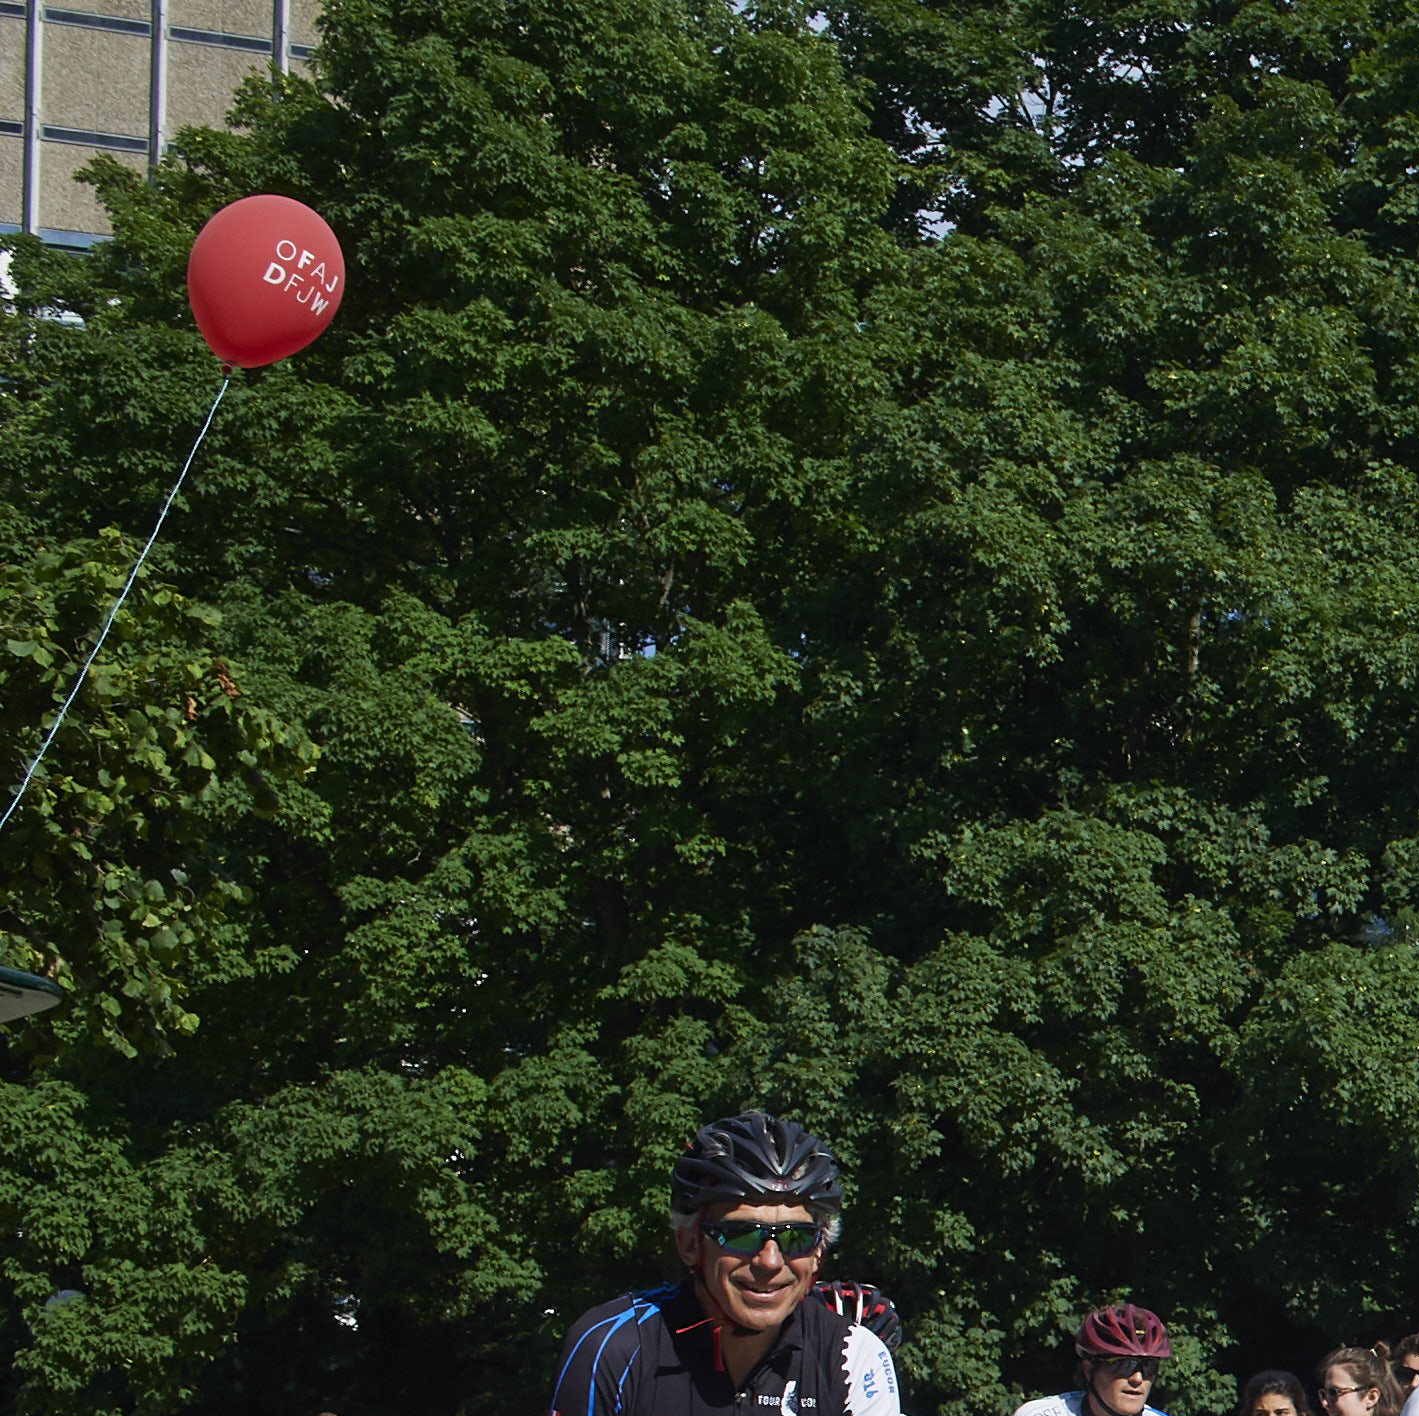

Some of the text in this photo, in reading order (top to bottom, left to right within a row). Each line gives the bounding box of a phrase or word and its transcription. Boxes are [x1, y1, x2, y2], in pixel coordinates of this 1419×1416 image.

[262, 262, 330, 316] DFJW
[276, 239, 338, 293] OFAJ
[878, 1350, 895, 1394] EUCOR
